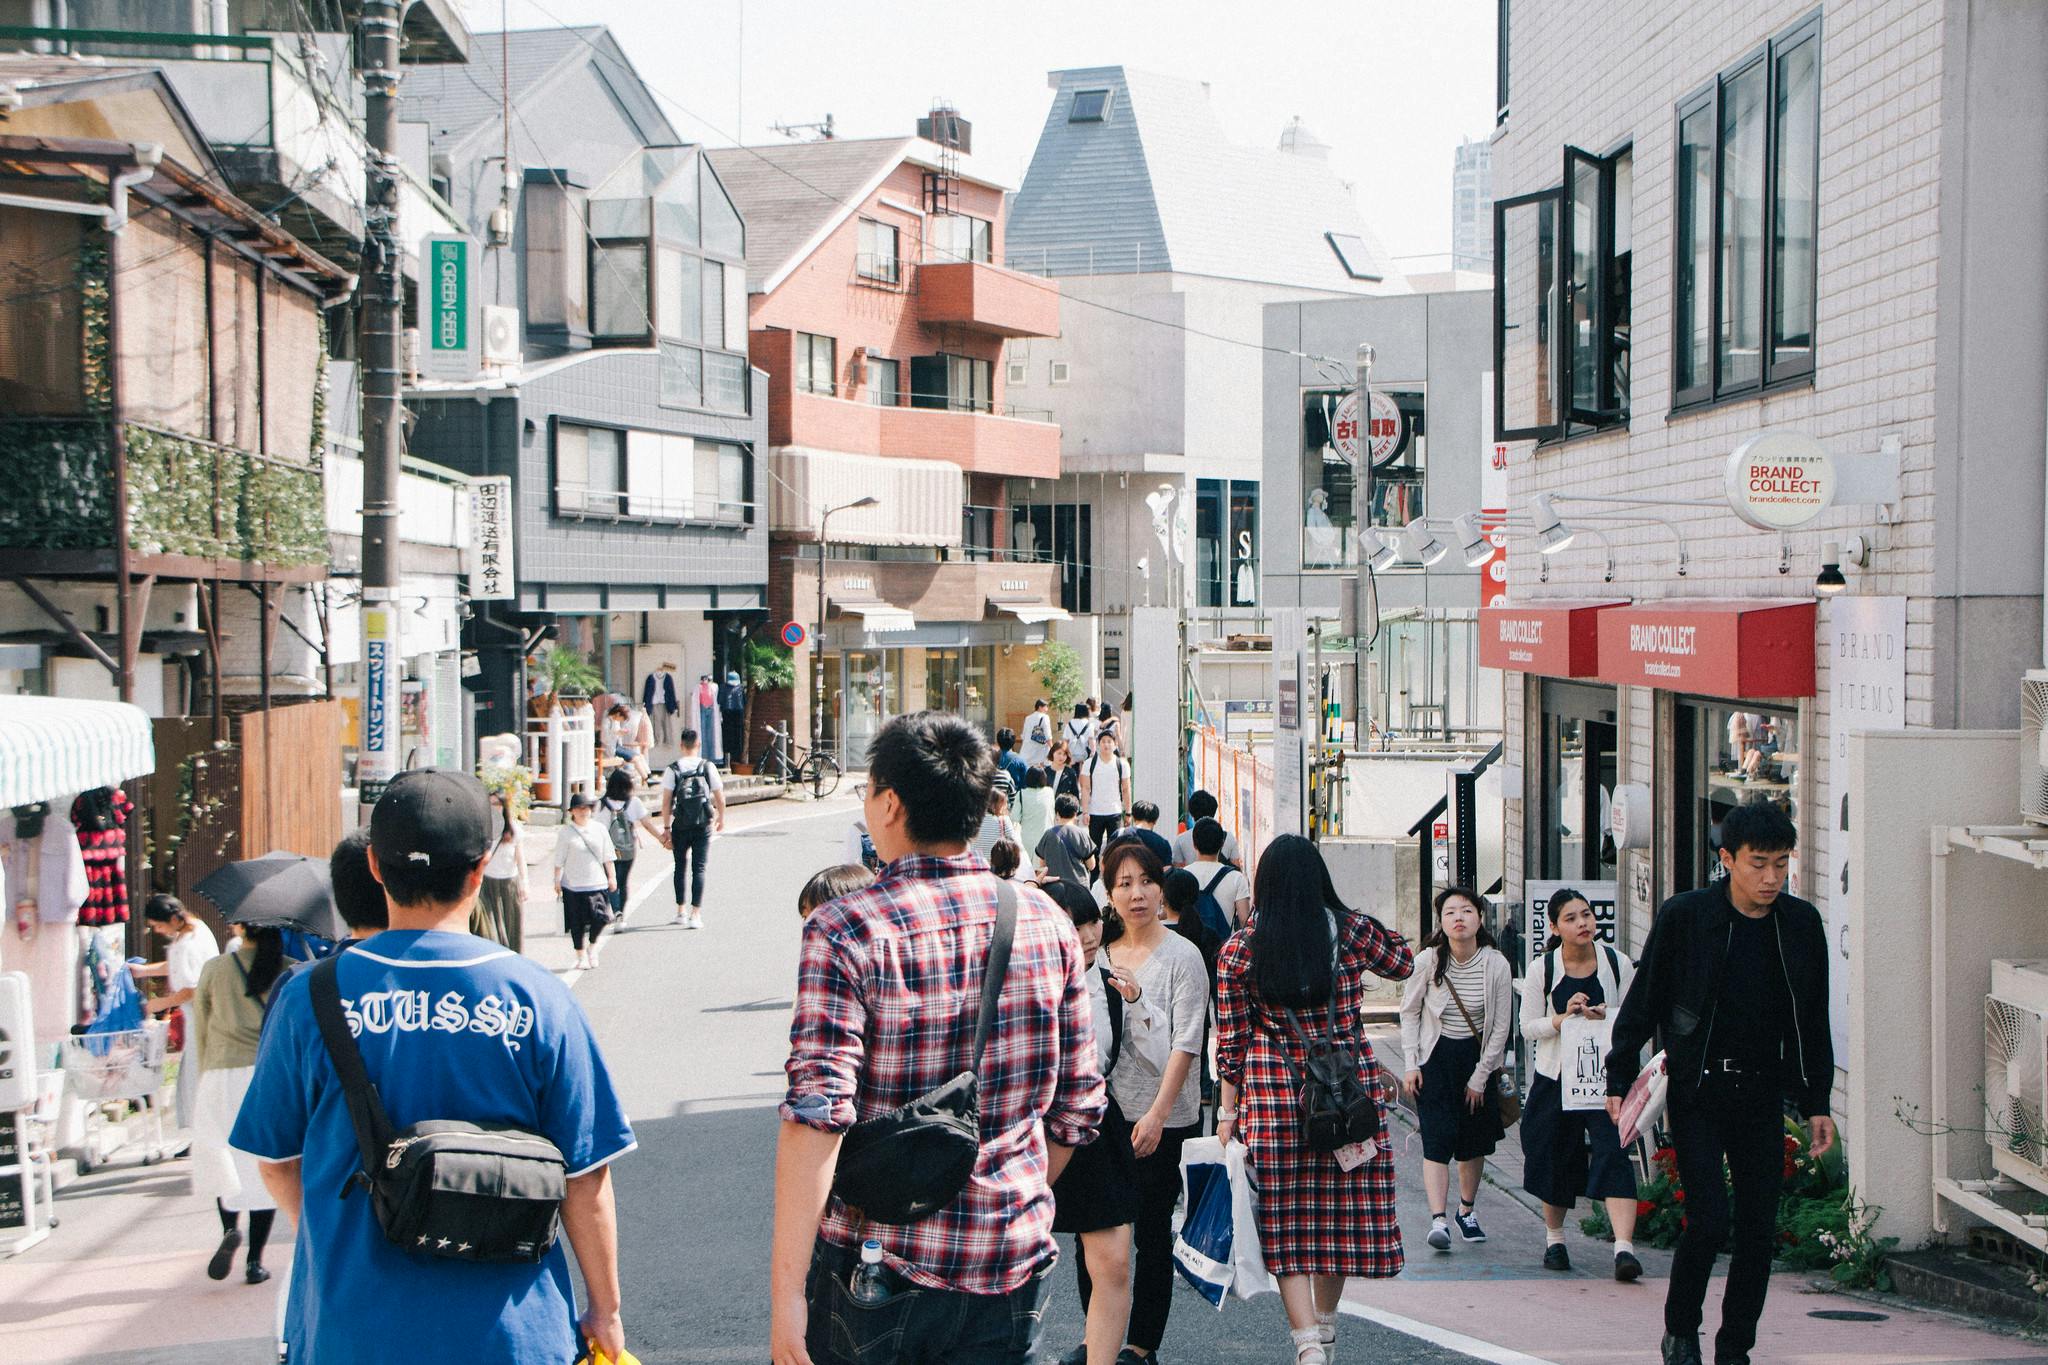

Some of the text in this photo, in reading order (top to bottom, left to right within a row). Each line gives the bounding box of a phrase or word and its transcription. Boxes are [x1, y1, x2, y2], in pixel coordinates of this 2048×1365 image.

[442, 262, 457, 309] GREEN
[442, 312, 457, 348] SEED
[1751, 466, 1803, 479] BRAND
[1750, 495, 1820, 504] brandcollect.com
[1238, 531, 1251, 559] S
[1500, 620, 1518, 642] BRAND
[1631, 624, 1656, 652] BRAND
[1840, 633, 1894, 660] BRAND
[1644, 660, 1681, 677] brandcollect.com
[1840, 683, 1893, 714] ITEMS
